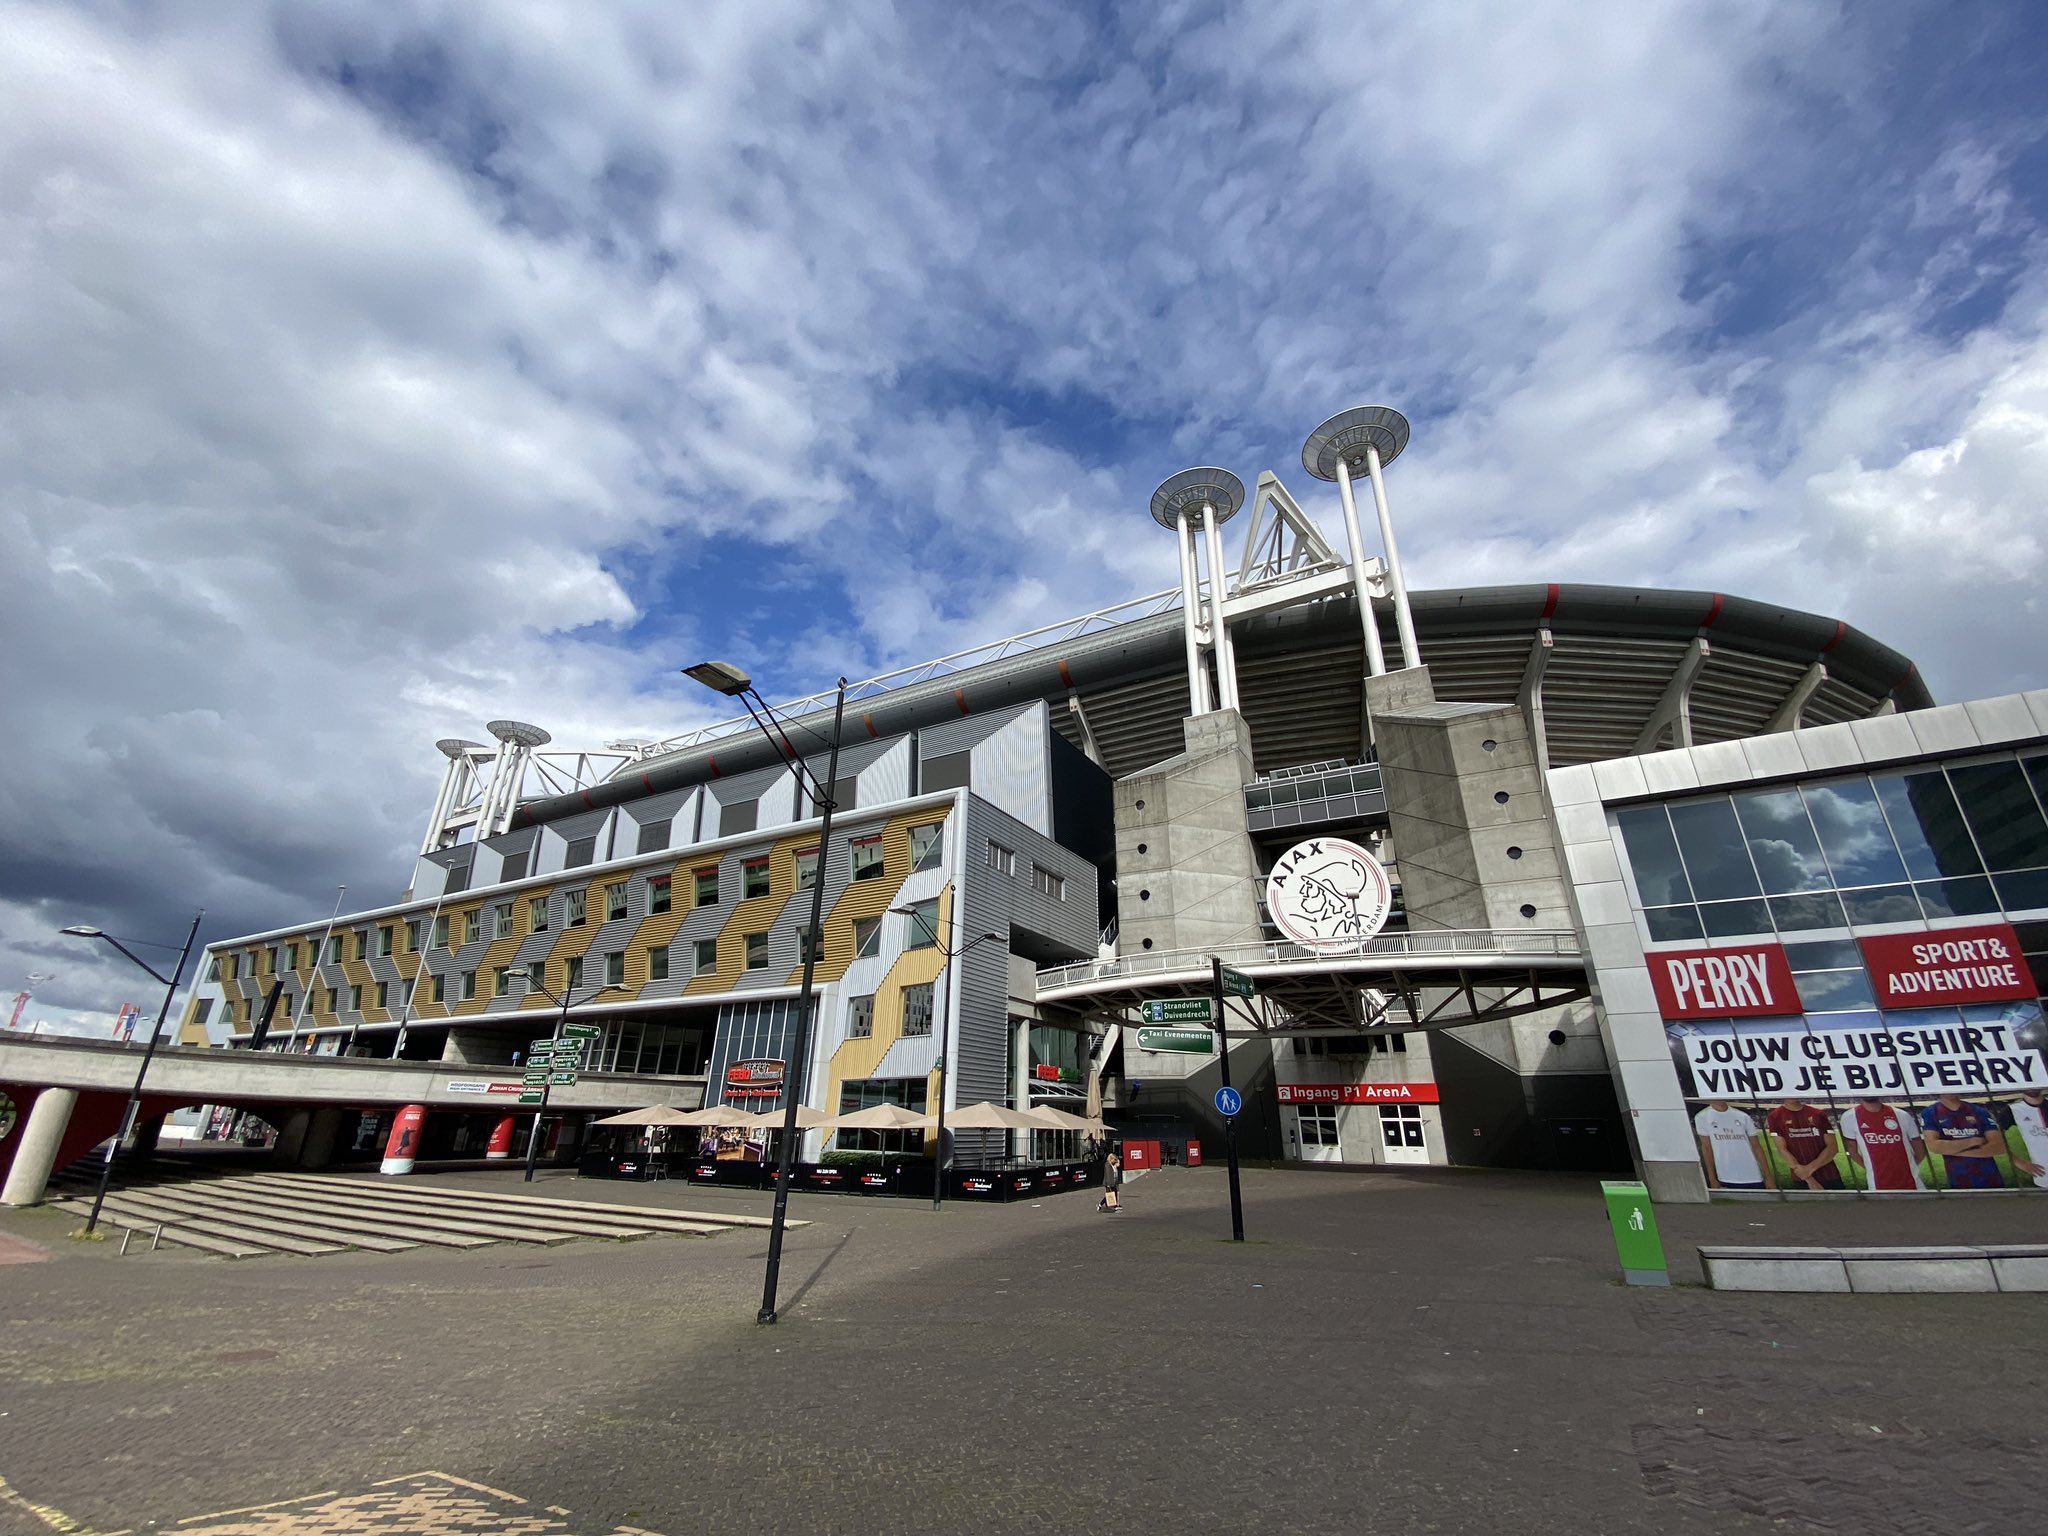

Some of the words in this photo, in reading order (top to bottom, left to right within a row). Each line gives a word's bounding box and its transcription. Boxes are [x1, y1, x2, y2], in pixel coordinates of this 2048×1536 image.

[1272, 841, 1324, 889] AJAX
[1911, 937, 2010, 965] SPORT&
[1666, 953, 1774, 1010] PERRY
[1888, 963, 2021, 994] ADVENTURE
[1163, 1002, 1202, 1010] Strandvliet
[1164, 1011, 1210, 1020] Duivendrecht
[1164, 1031, 1212, 1040] Evenementen
[1694, 1036, 1790, 1064] JOUW
[1800, 1025, 2006, 1060] CLUBSHIRT
[1697, 1067, 1784, 1093] VIND
[1794, 1065, 1837, 1092] JE
[1842, 1062, 1902, 1090] BIJ
[1909, 1055, 2034, 1088] PERRY
[1293, 1086, 1340, 1100] Ingang
[1343, 1086, 1360, 1098] P1
[1366, 1085, 1411, 1098] ArenA
[1714, 1132, 1747, 1142] Emirates
[1863, 1132, 1901, 1144] Ziggo
[1942, 1127, 1979, 1137] Rakuten
